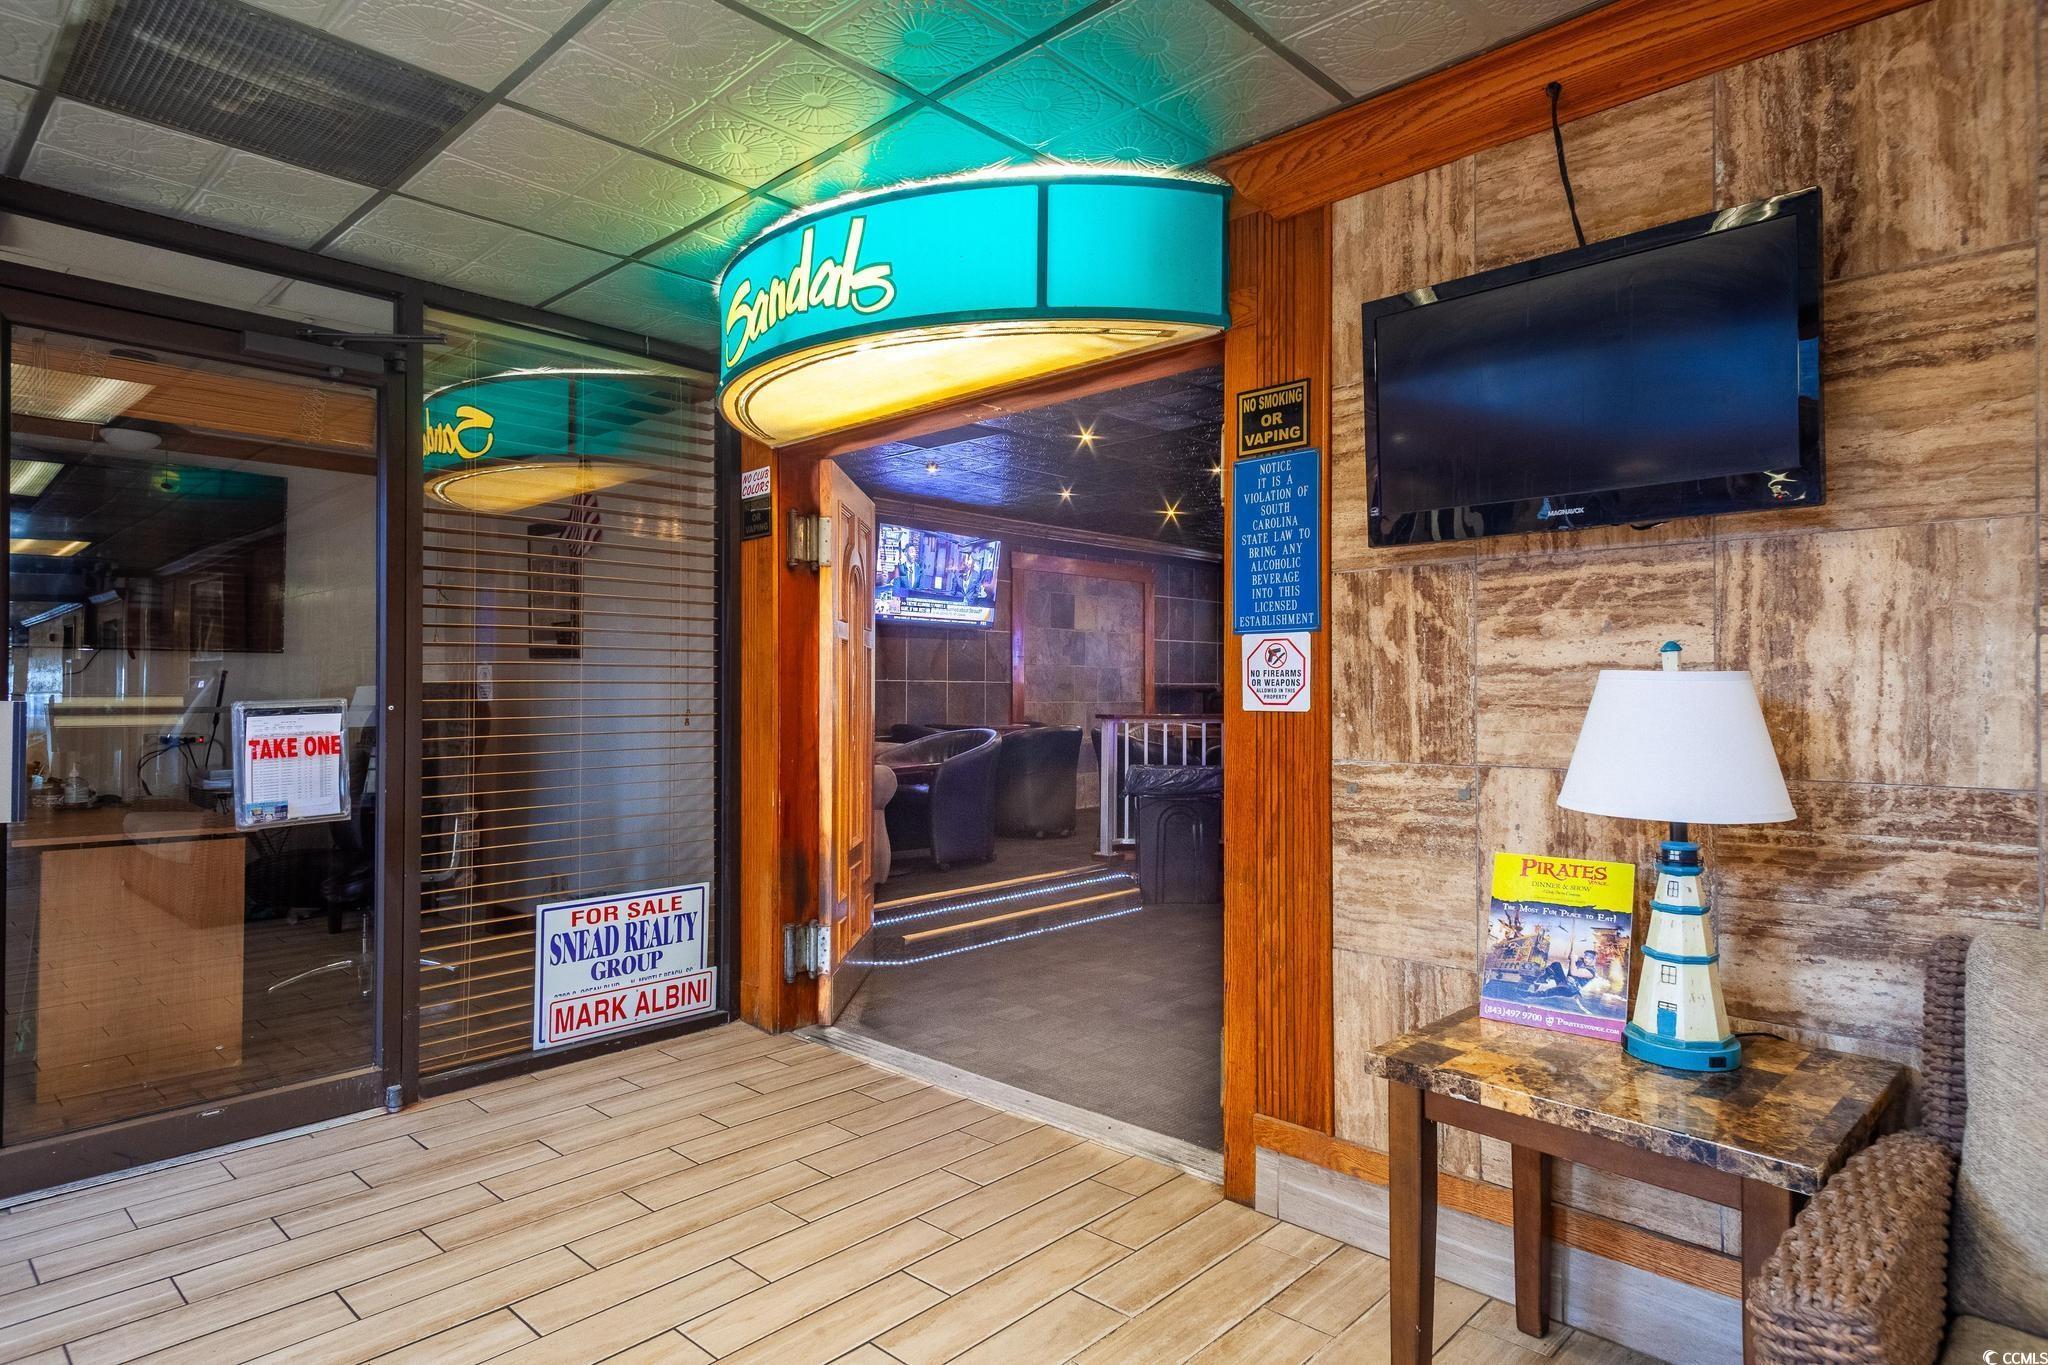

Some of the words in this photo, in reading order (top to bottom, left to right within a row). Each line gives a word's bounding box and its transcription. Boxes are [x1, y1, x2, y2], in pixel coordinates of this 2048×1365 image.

[725, 216, 896, 369] Sandals
[1243, 399, 1257, 413] NO
[1259, 388, 1303, 410] SMOKING
[1260, 412, 1283, 427] OR
[1244, 426, 1301, 447] VAPING
[1260, 460, 1292, 475] NOTICE
[742, 474, 752, 484] NO
[753, 469, 769, 481] CLUB
[1258, 477, 1267, 490] IT
[1272, 475, 1281, 487] IS
[1286, 474, 1293, 485] A
[742, 481, 769, 496] COLORS
[1244, 488, 1292, 505] VIOLATION
[1297, 485, 1309, 497] OF
[1260, 502, 1290, 516] SOUTH
[1547, 507, 1585, 517] MAGNAVOX
[1252, 516, 1298, 531] CAROLINA
[1241, 533, 1268, 546] STATE
[1273, 529, 1293, 542] LAW
[1298, 527, 1311, 540] TO
[1248, 546, 1276, 559] BRING
[1282, 542, 1303, 555] ANY
[1250, 557, 1301, 573] ALCOHOLIC
[1252, 571, 1300, 586] BEVERAGE
[1252, 587, 1273, 600] INTO
[1278, 585, 1300, 597] THIS
[1254, 600, 1298, 613] LICENSED
[1239, 612, 1315, 628] ESTABLISHMENT
[1250, 669, 1261, 678] NO
[1263, 669, 1302, 678] FIREARMS
[1251, 679, 1262, 687] OR
[1264, 678, 1301, 687] WEAPONS
[248, 736, 299, 761] TAKE
[303, 734, 342, 758] ONE
[1520, 858, 1609, 881] PIRATES
[1531, 880, 1561, 890] DINNER
[1569, 885, 1592, 893] SHOW
[571, 905, 619, 928] FOR
[627, 895, 683, 919] SALE
[549, 924, 621, 967] SNEAD
[624, 910, 699, 954] REALTY
[590, 950, 664, 982] GROUP
[555, 994, 628, 1035] MARK
[634, 978, 708, 1018] ALBINI
[1522, 1011, 1542, 1022] 9700
